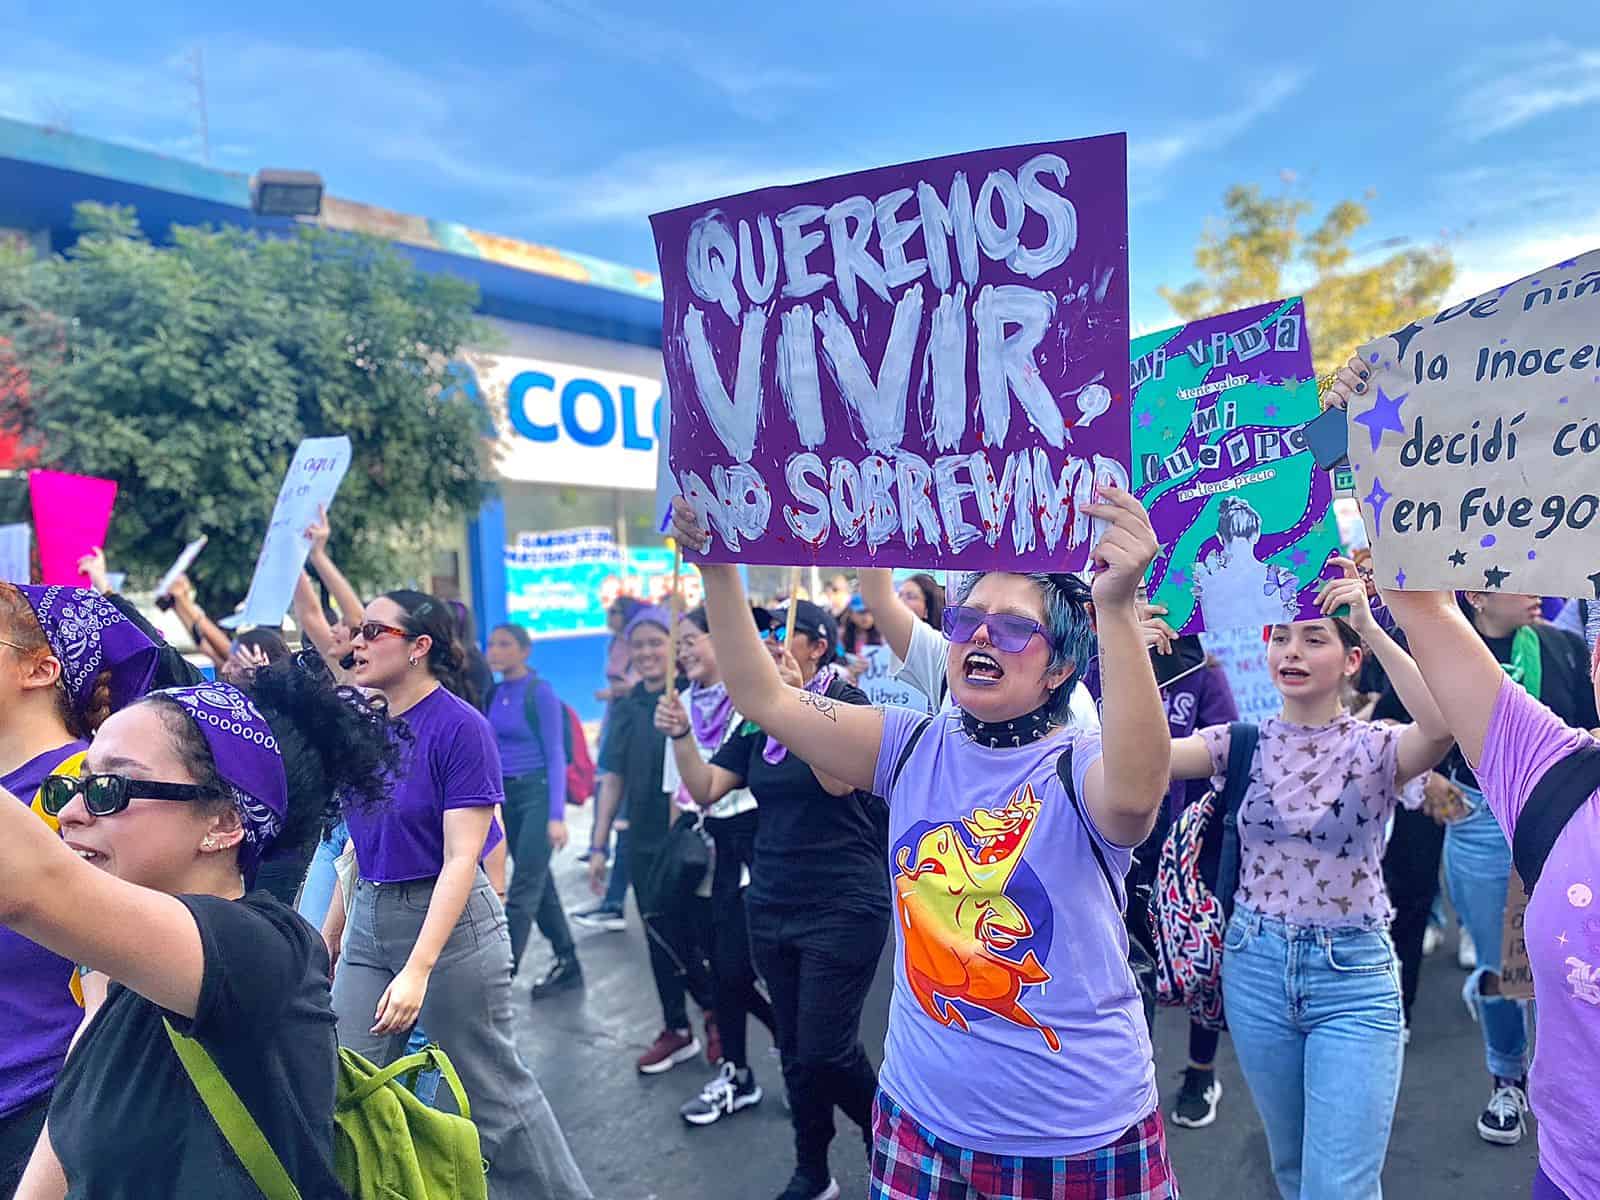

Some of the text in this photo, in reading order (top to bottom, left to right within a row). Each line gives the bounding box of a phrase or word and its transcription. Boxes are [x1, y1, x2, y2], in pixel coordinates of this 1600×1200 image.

[686, 154, 1077, 325] QUEREMOS
[1415, 345, 1600, 383] la Inoce
[1178, 374, 1248, 400] tiene valor
[507, 370, 661, 451] COL
[1400, 411, 1526, 467] decidí
[1178, 470, 1275, 500] no tiene precio
[680, 463, 771, 554] NO
[1393, 500, 1441, 533] en
[870, 688, 910, 705] libres
